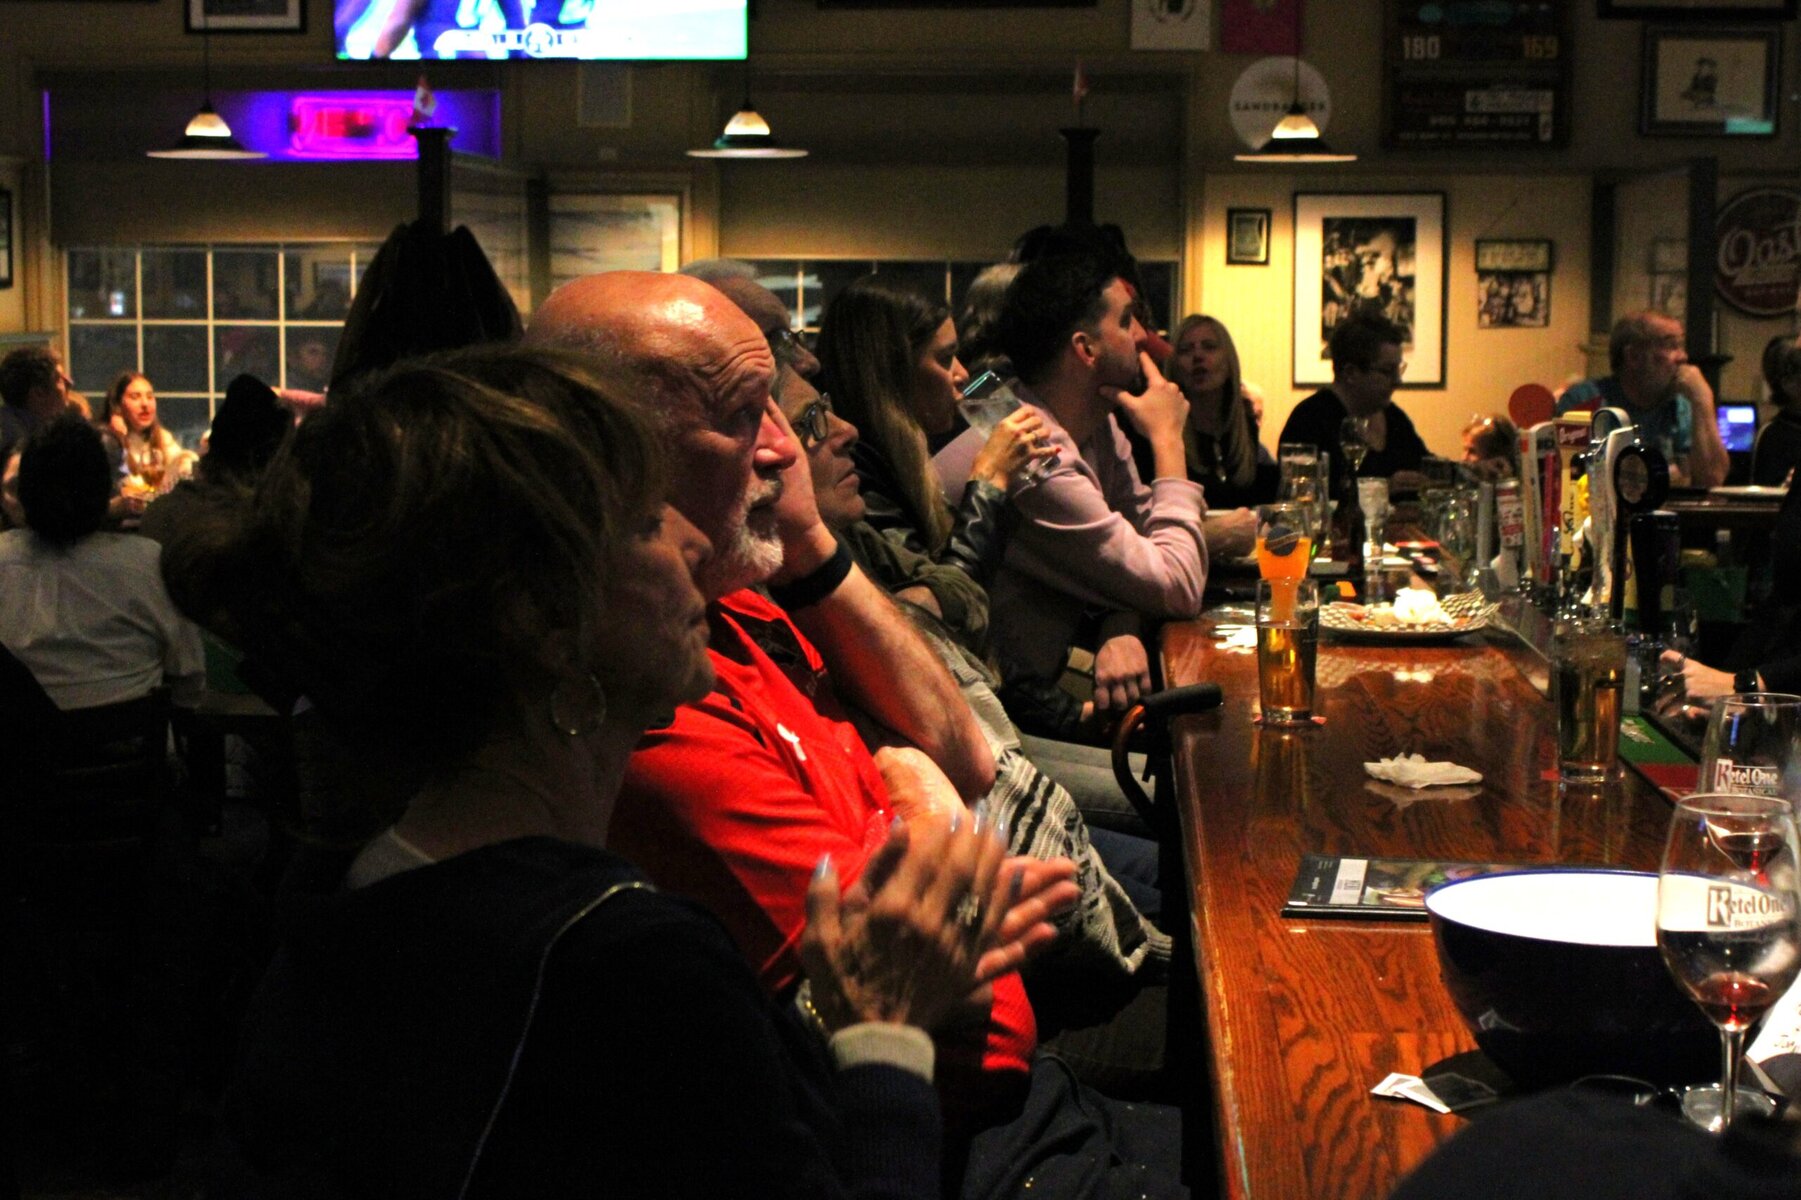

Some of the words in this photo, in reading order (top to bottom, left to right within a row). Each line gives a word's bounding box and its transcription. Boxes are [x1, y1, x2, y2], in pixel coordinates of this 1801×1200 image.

[1402, 35, 1441, 60] 180
[1522, 35, 1560, 60] 169
[1234, 101, 1326, 111] SANDBAER
[1714, 759, 1751, 794] Ketel
[1751, 768, 1778, 786] One
[1707, 886, 1756, 927] Ketel
[1758, 894, 1786, 914] One
